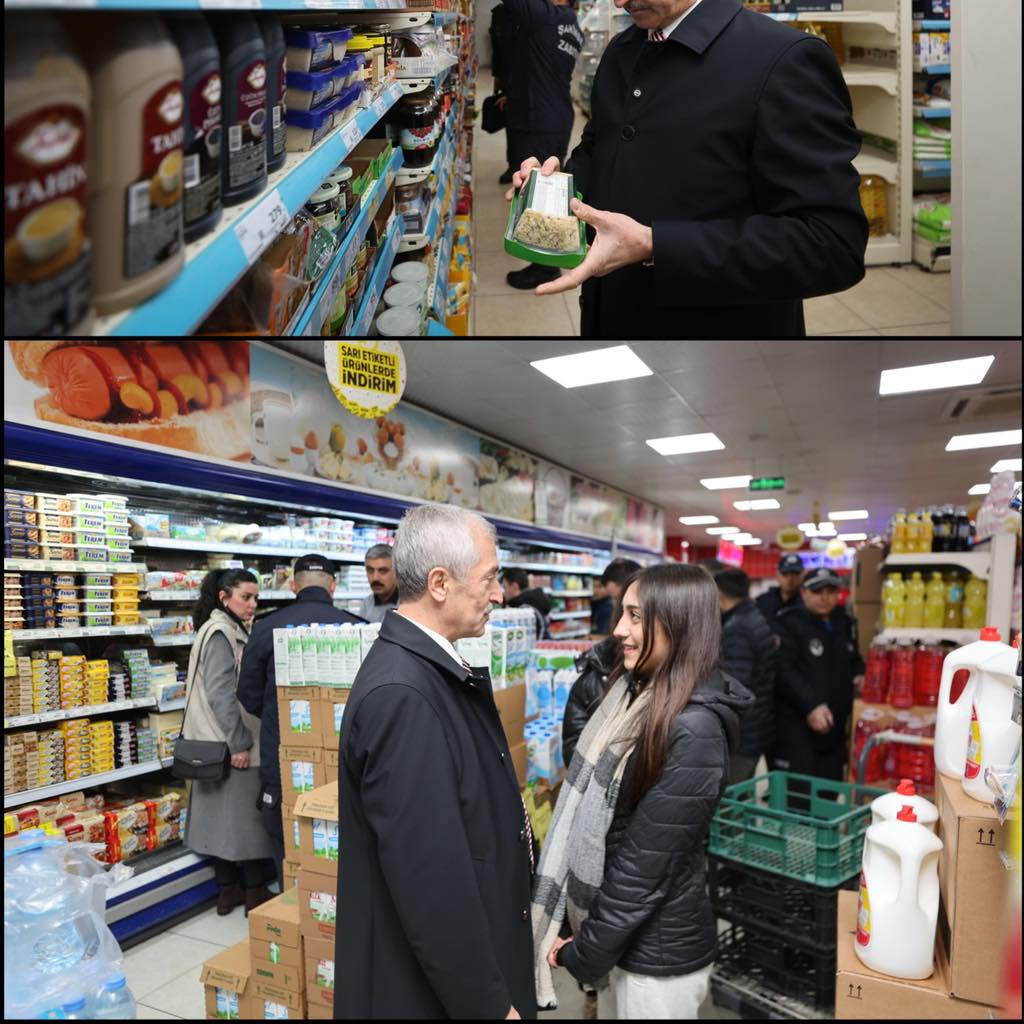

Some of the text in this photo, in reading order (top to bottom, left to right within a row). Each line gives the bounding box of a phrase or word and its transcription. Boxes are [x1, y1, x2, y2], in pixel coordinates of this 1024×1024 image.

[341, 345, 396, 367] SARI ETİKETLİ
[342, 358, 396, 378] ÜRÜNLERDE
[342, 370, 397, 394] İNDİRİM
